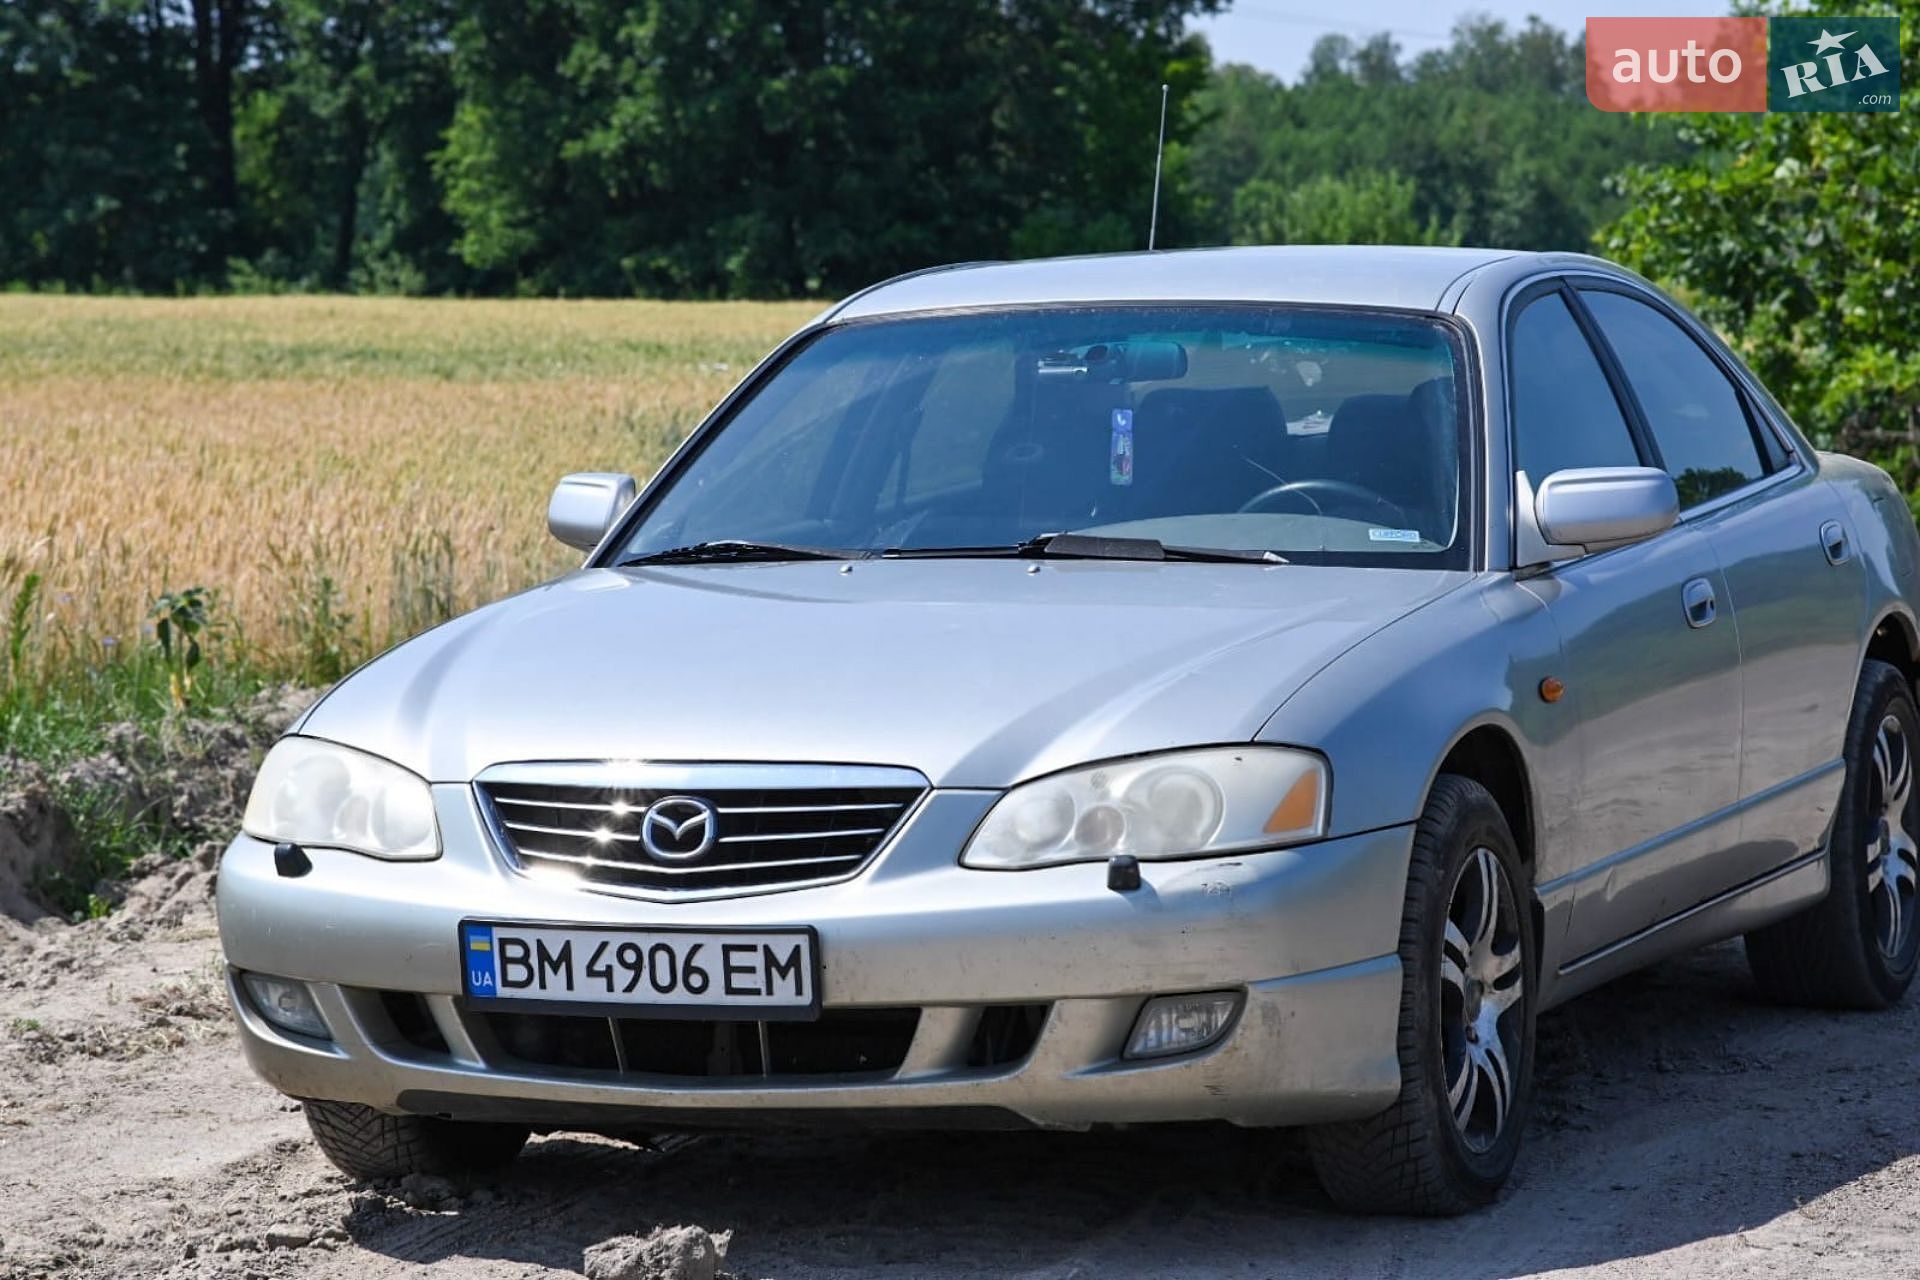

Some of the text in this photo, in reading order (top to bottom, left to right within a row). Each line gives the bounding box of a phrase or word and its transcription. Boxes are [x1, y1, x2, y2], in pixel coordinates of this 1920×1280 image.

[472, 970, 493, 987] UA
[498, 937, 803, 996] BM 4906 EM
